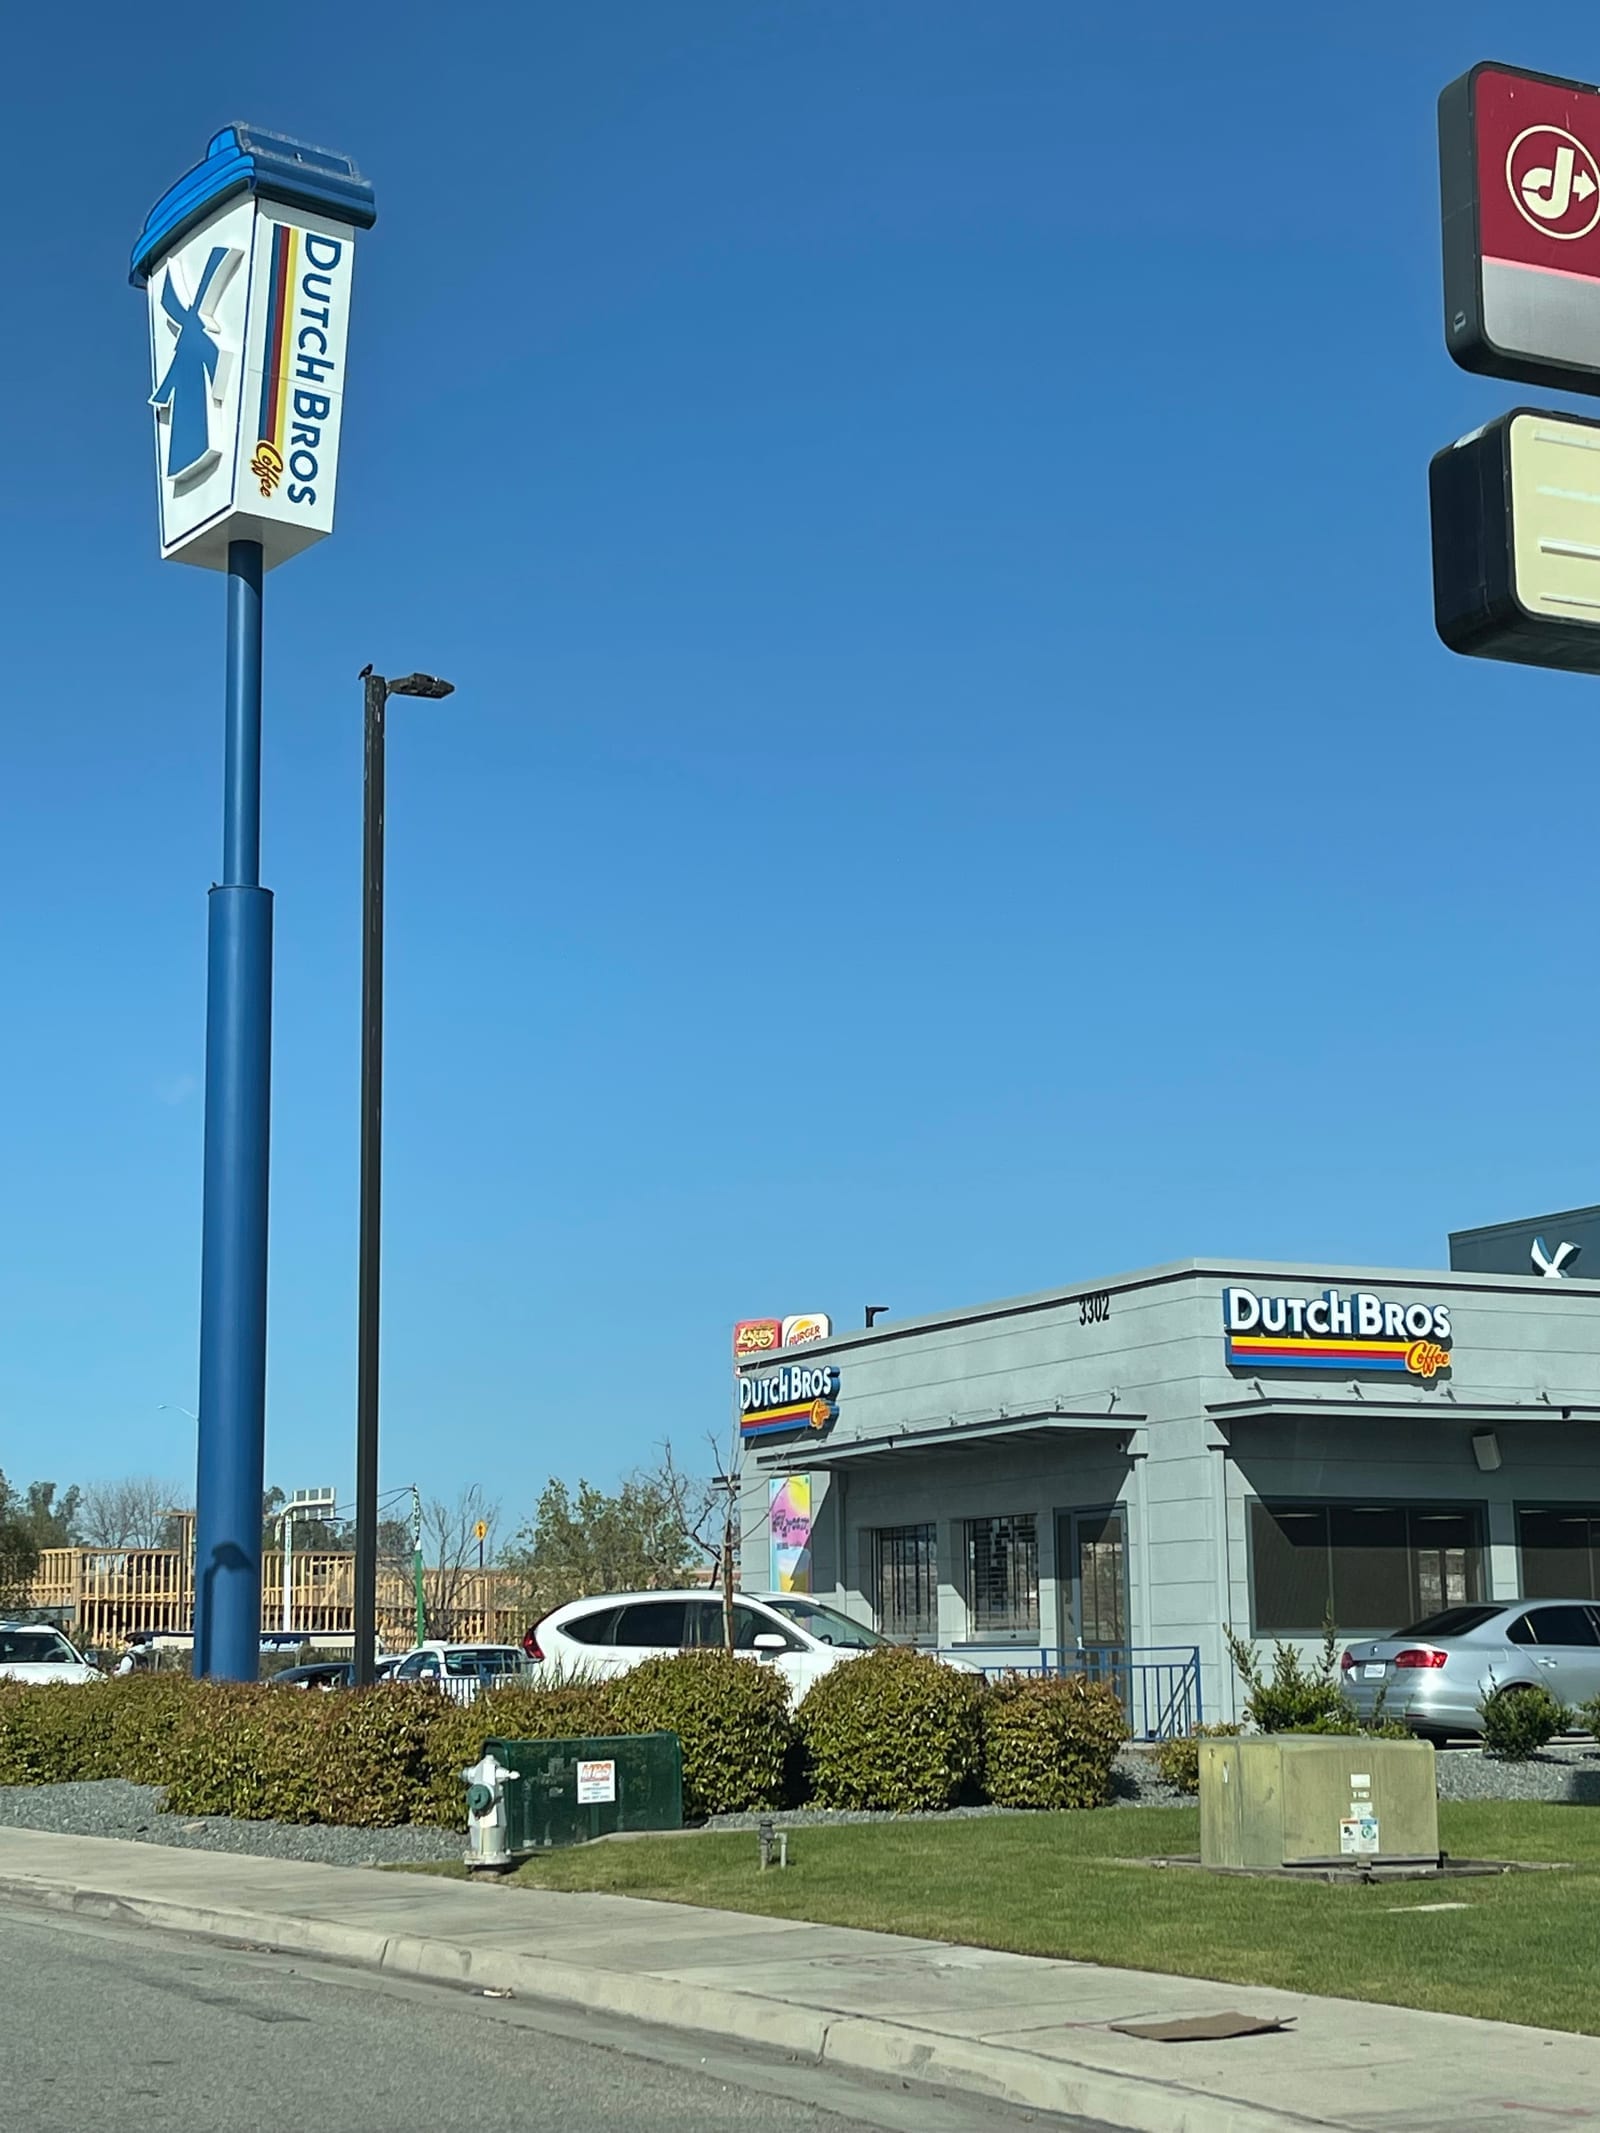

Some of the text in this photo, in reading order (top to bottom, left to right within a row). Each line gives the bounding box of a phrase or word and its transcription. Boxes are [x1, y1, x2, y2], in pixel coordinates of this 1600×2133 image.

[287, 232, 342, 506] DUTCH BROS
[250, 441, 283, 498] Coffee
[1079, 1293, 1110, 1326] 3302
[1229, 1288, 1451, 1339] DUTCH BROS
[1407, 1340, 1449, 1376] Coffee
[740, 1366, 832, 1410] DUTCH BROS
